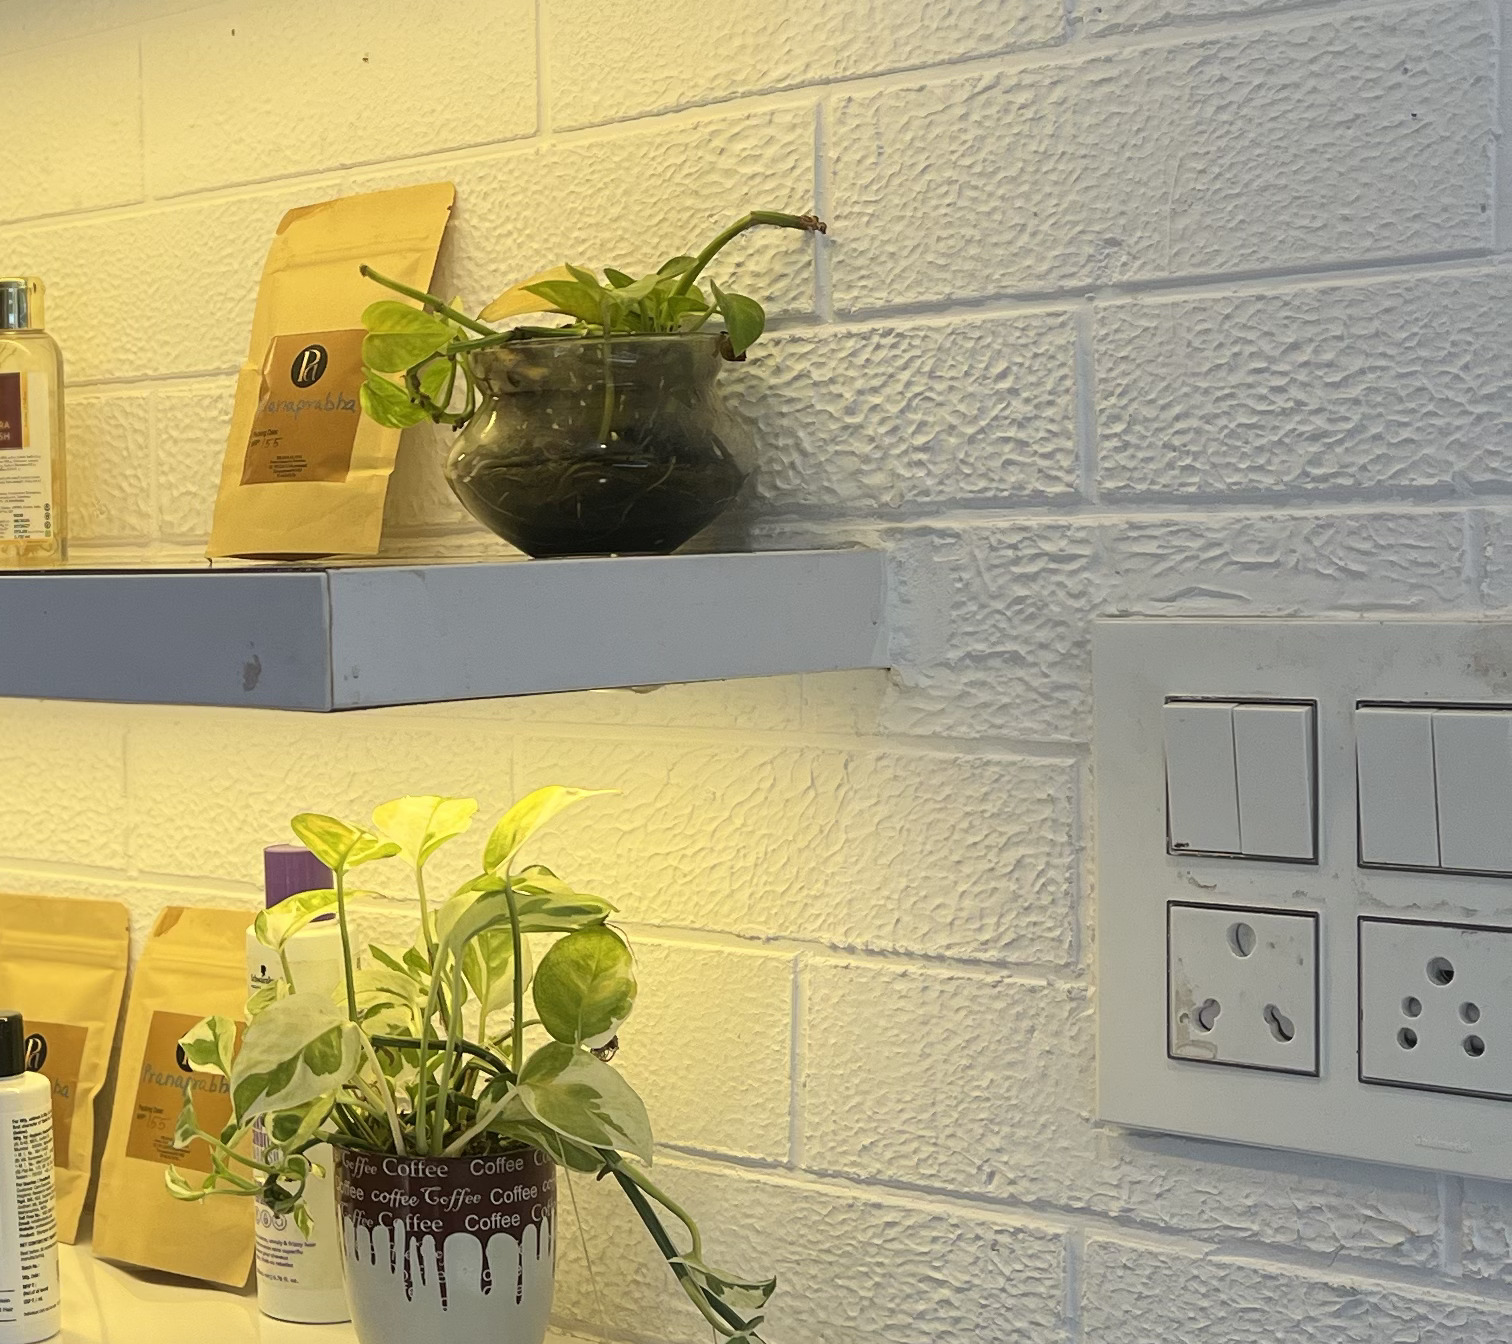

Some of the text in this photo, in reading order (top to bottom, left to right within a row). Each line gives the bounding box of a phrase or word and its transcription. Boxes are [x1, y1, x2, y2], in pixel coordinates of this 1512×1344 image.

[342, 1151, 377, 1178] Coffee
[383, 1158, 448, 1177] Coffee
[470, 1157, 524, 1176] Coffee
[371, 1189, 419, 1207] coffee
[420, 1186, 481, 1212] Coffee
[490, 1185, 537, 1205] Coffee
[465, 1211, 520, 1231] Coffee
